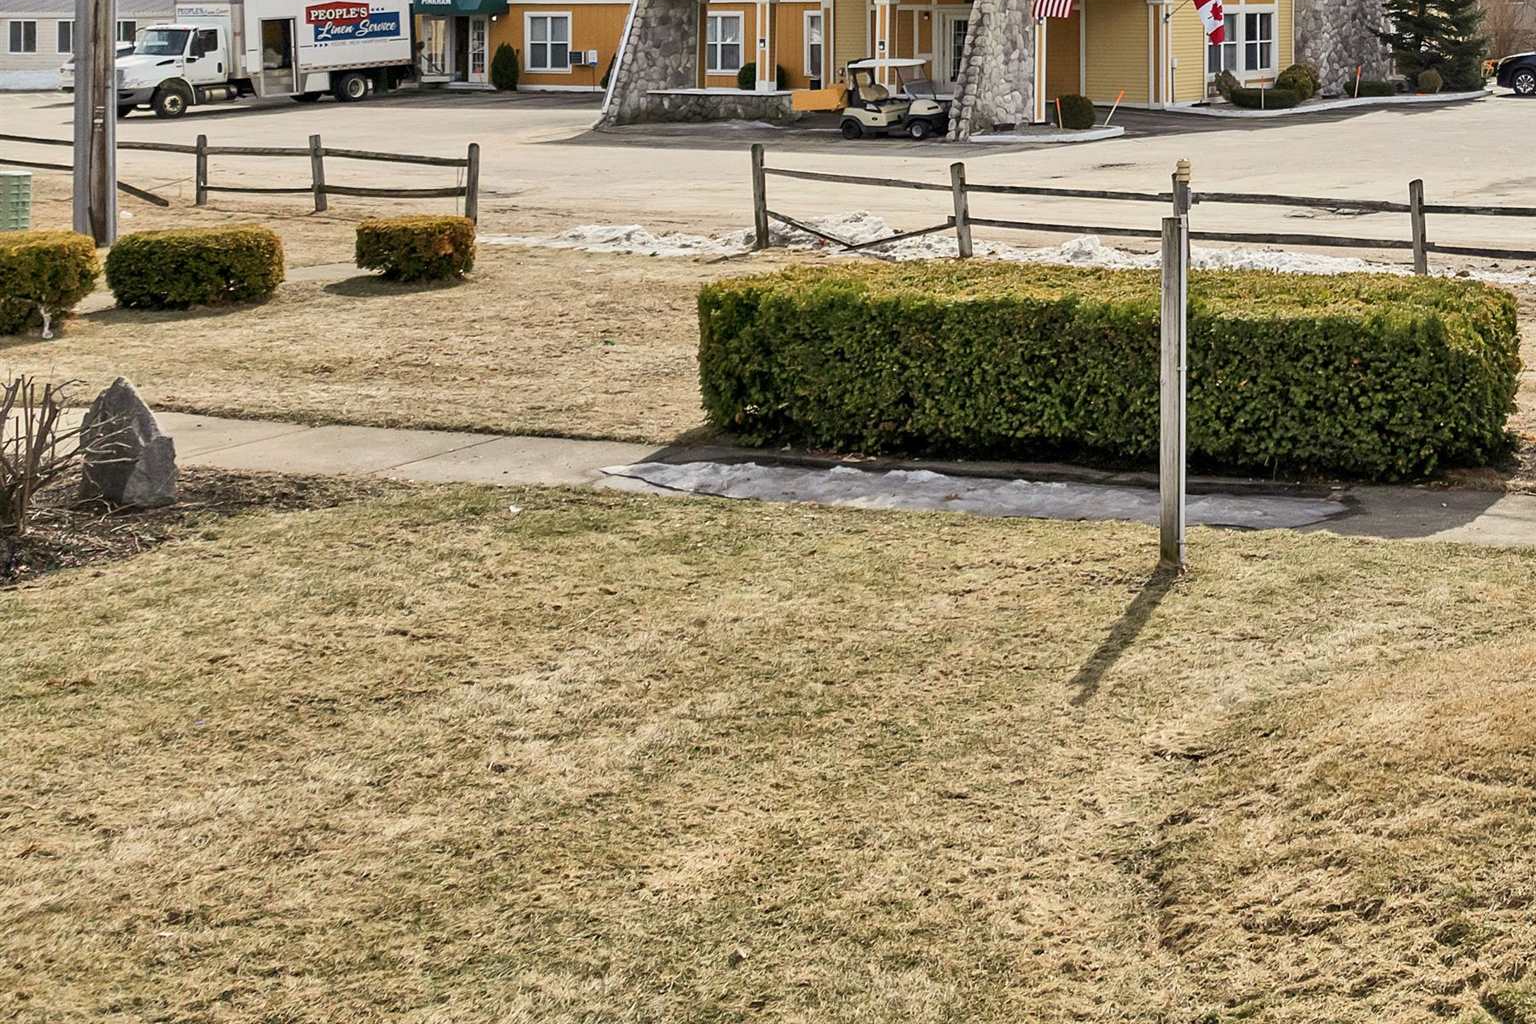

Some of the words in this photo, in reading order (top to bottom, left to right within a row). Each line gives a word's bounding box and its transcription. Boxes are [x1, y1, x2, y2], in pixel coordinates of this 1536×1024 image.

[310, 7, 368, 21] PEOPLE'S
[316, 21, 353, 40] Linen
[355, 19, 397, 37] Service
